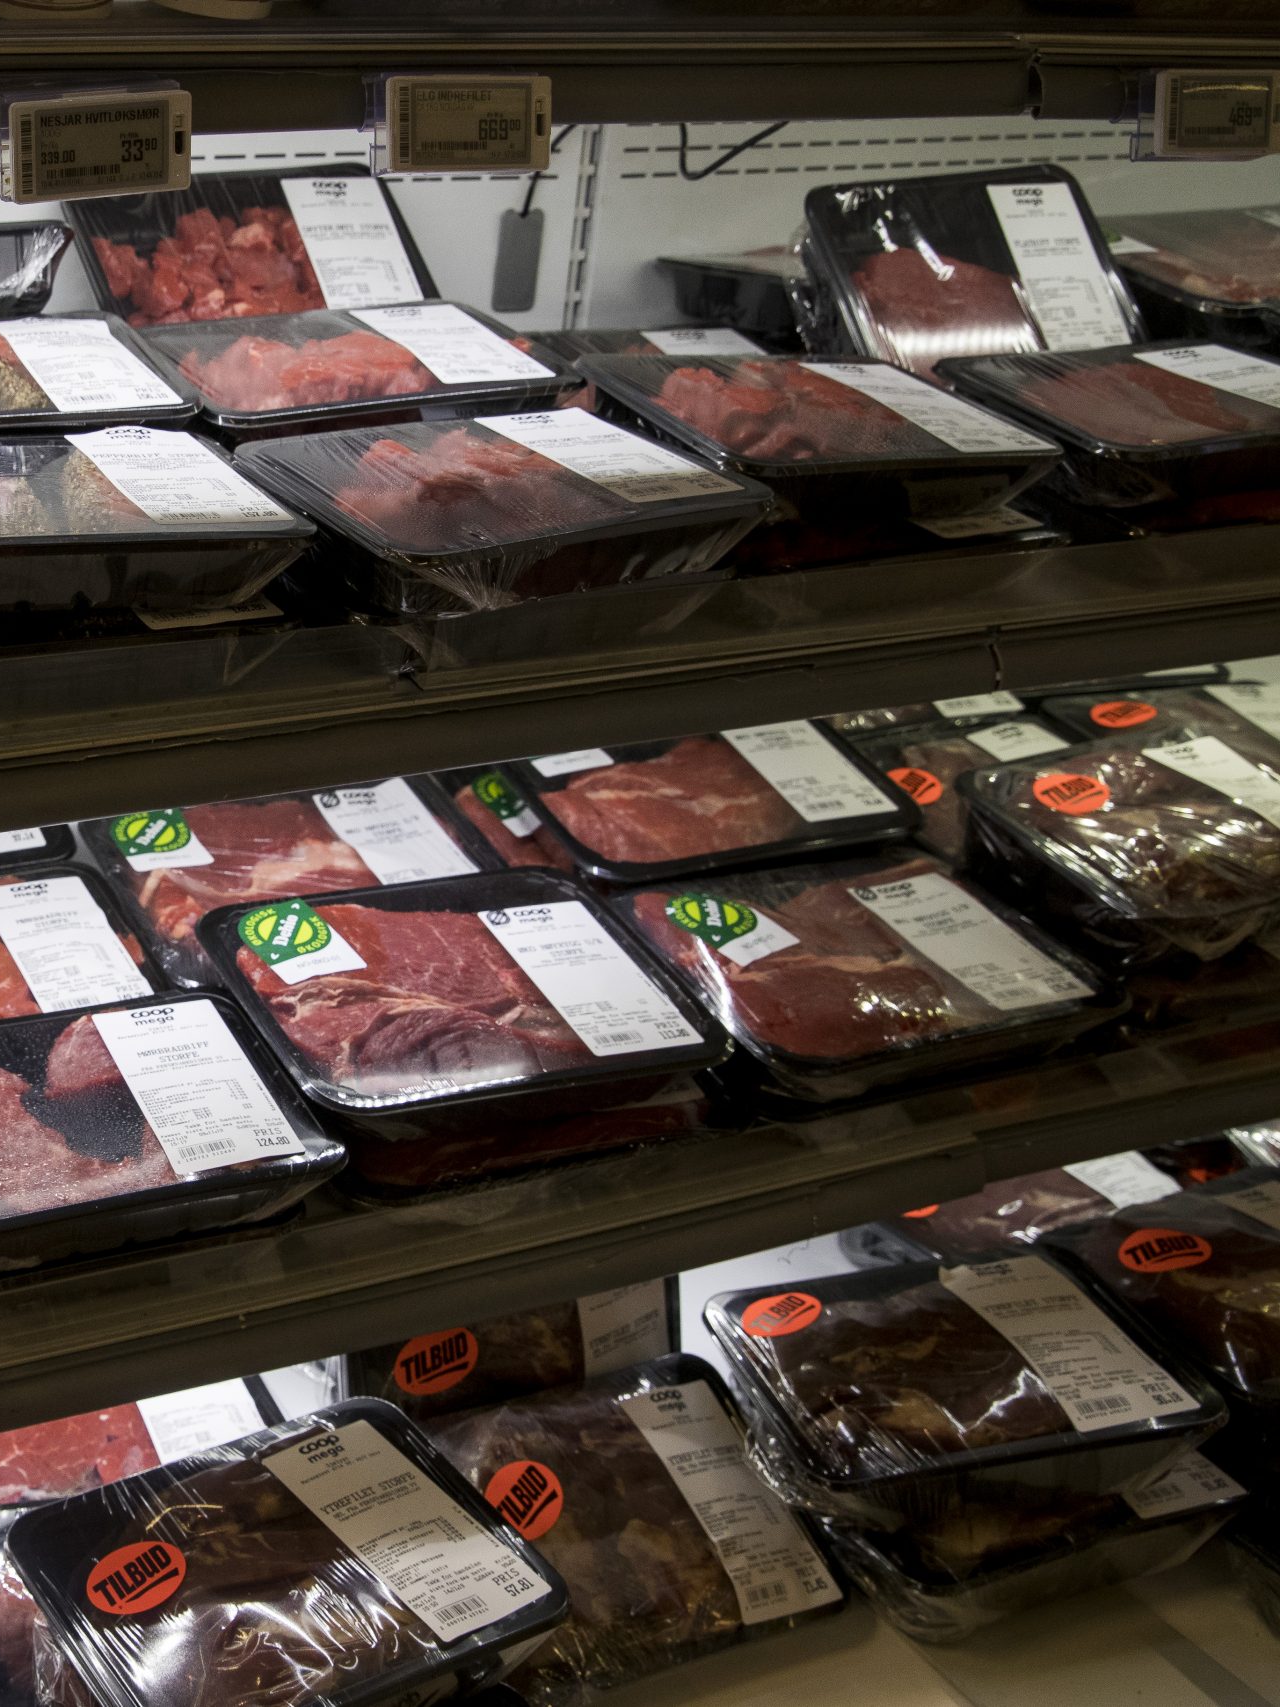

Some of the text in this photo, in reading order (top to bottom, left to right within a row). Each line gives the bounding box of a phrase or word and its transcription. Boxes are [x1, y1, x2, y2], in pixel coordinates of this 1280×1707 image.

[40, 108, 160, 127] NESJAR HVITLØKSMØR
[40, 150, 76, 165] 339.00
[105, 428, 152, 436] coop
[1040, 777, 1096, 806] TILBUD
[272, 914, 299, 946] Debio
[296, 916, 328, 954] ØKOLOGISK
[130, 1007, 175, 1020] coop
[134, 1015, 175, 1027] mega
[137, 1041, 210, 1059] MØRBRADBIFF
[159, 1051, 200, 1063] STORFE
[253, 1127, 283, 1137] PRIS
[255, 1136, 291, 1149] 124.80
[1123, 1233, 1200, 1268] TILBUD
[748, 1294, 806, 1334] TILBUD
[400, 1333, 469, 1385] TILBUD
[298, 1434, 340, 1455] coop
[307, 1444, 345, 1464] mega
[320, 1486, 376, 1515] YTREFILET
[378, 1471, 416, 1492] STORFE
[91, 1544, 173, 1609] TILBUD
[492, 1568, 520, 1587] PRIS
[504, 1577, 535, 1598] 57.81
